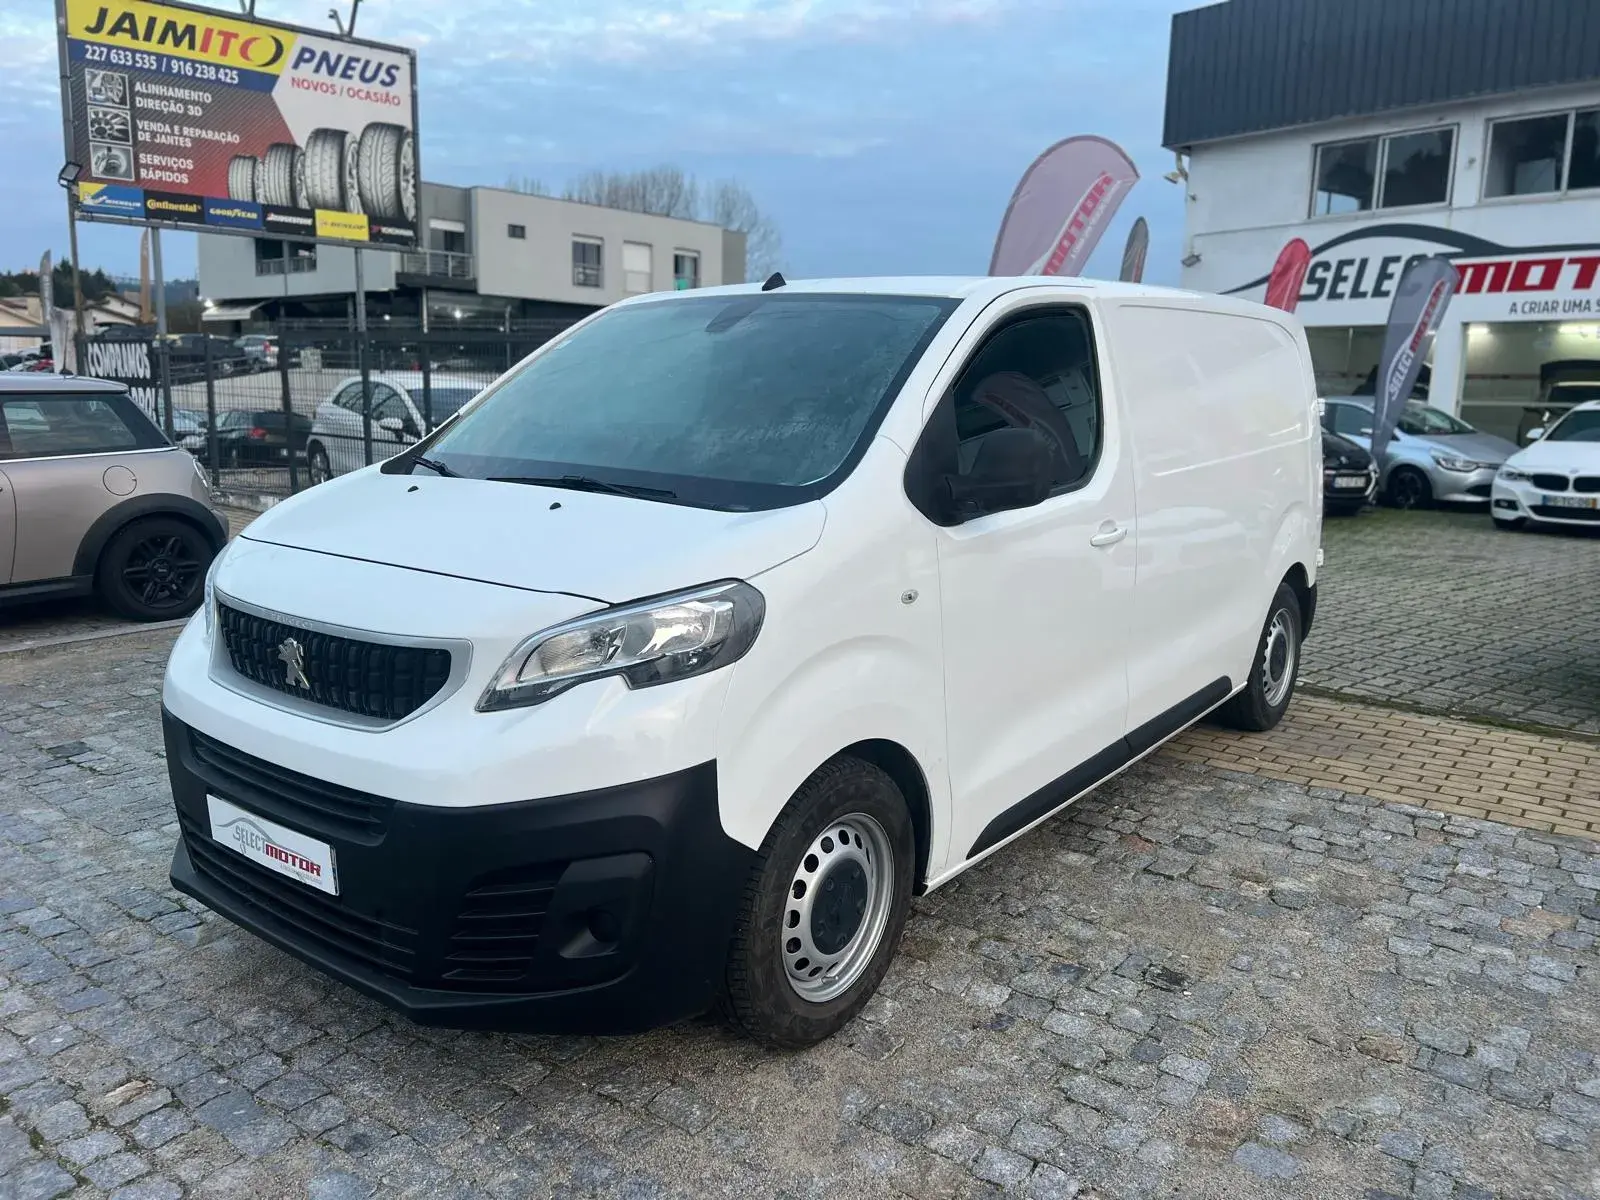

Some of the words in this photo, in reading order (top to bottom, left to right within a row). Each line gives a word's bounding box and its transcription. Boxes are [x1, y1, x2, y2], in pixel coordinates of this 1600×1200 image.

[85, 7, 284, 67] JAIMITO
[84, 44, 107, 61] 227
[110, 48, 132, 66] 633
[135, 53, 157, 70] 535
[161, 57, 166, 73] /
[171, 61, 192, 76] 916
[195, 64, 216, 80] 238
[218, 68, 239, 84] 425
[291, 46, 400, 87] PNEUS
[135, 82, 212, 103] ALINHAMENTO
[291, 77, 337, 95] NOVOS
[347, 87, 401, 106] OCASIÃO
[135, 97, 184, 114] DIREÇÃO
[187, 105, 202, 116] 3D
[136, 119, 171, 134] VENDA
[173, 125, 180, 135] E
[183, 126, 240, 144] REPARAÇÃO
[138, 131, 151, 142] DE
[154, 134, 192, 148] JANTES
[139, 153, 194, 170] SERVIÇOS
[140, 167, 189, 184] RÁPIDOS
[147, 199, 198, 213] Continental
[1508, 301, 1518, 314] A
[1521, 300, 1560, 314] CRIAR
[1562, 299, 1592, 313] UMA
[87, 342, 151, 379] COMPRAMOS
[232, 825, 266, 853] SELECT
[265, 843, 321, 877] MOTOR
